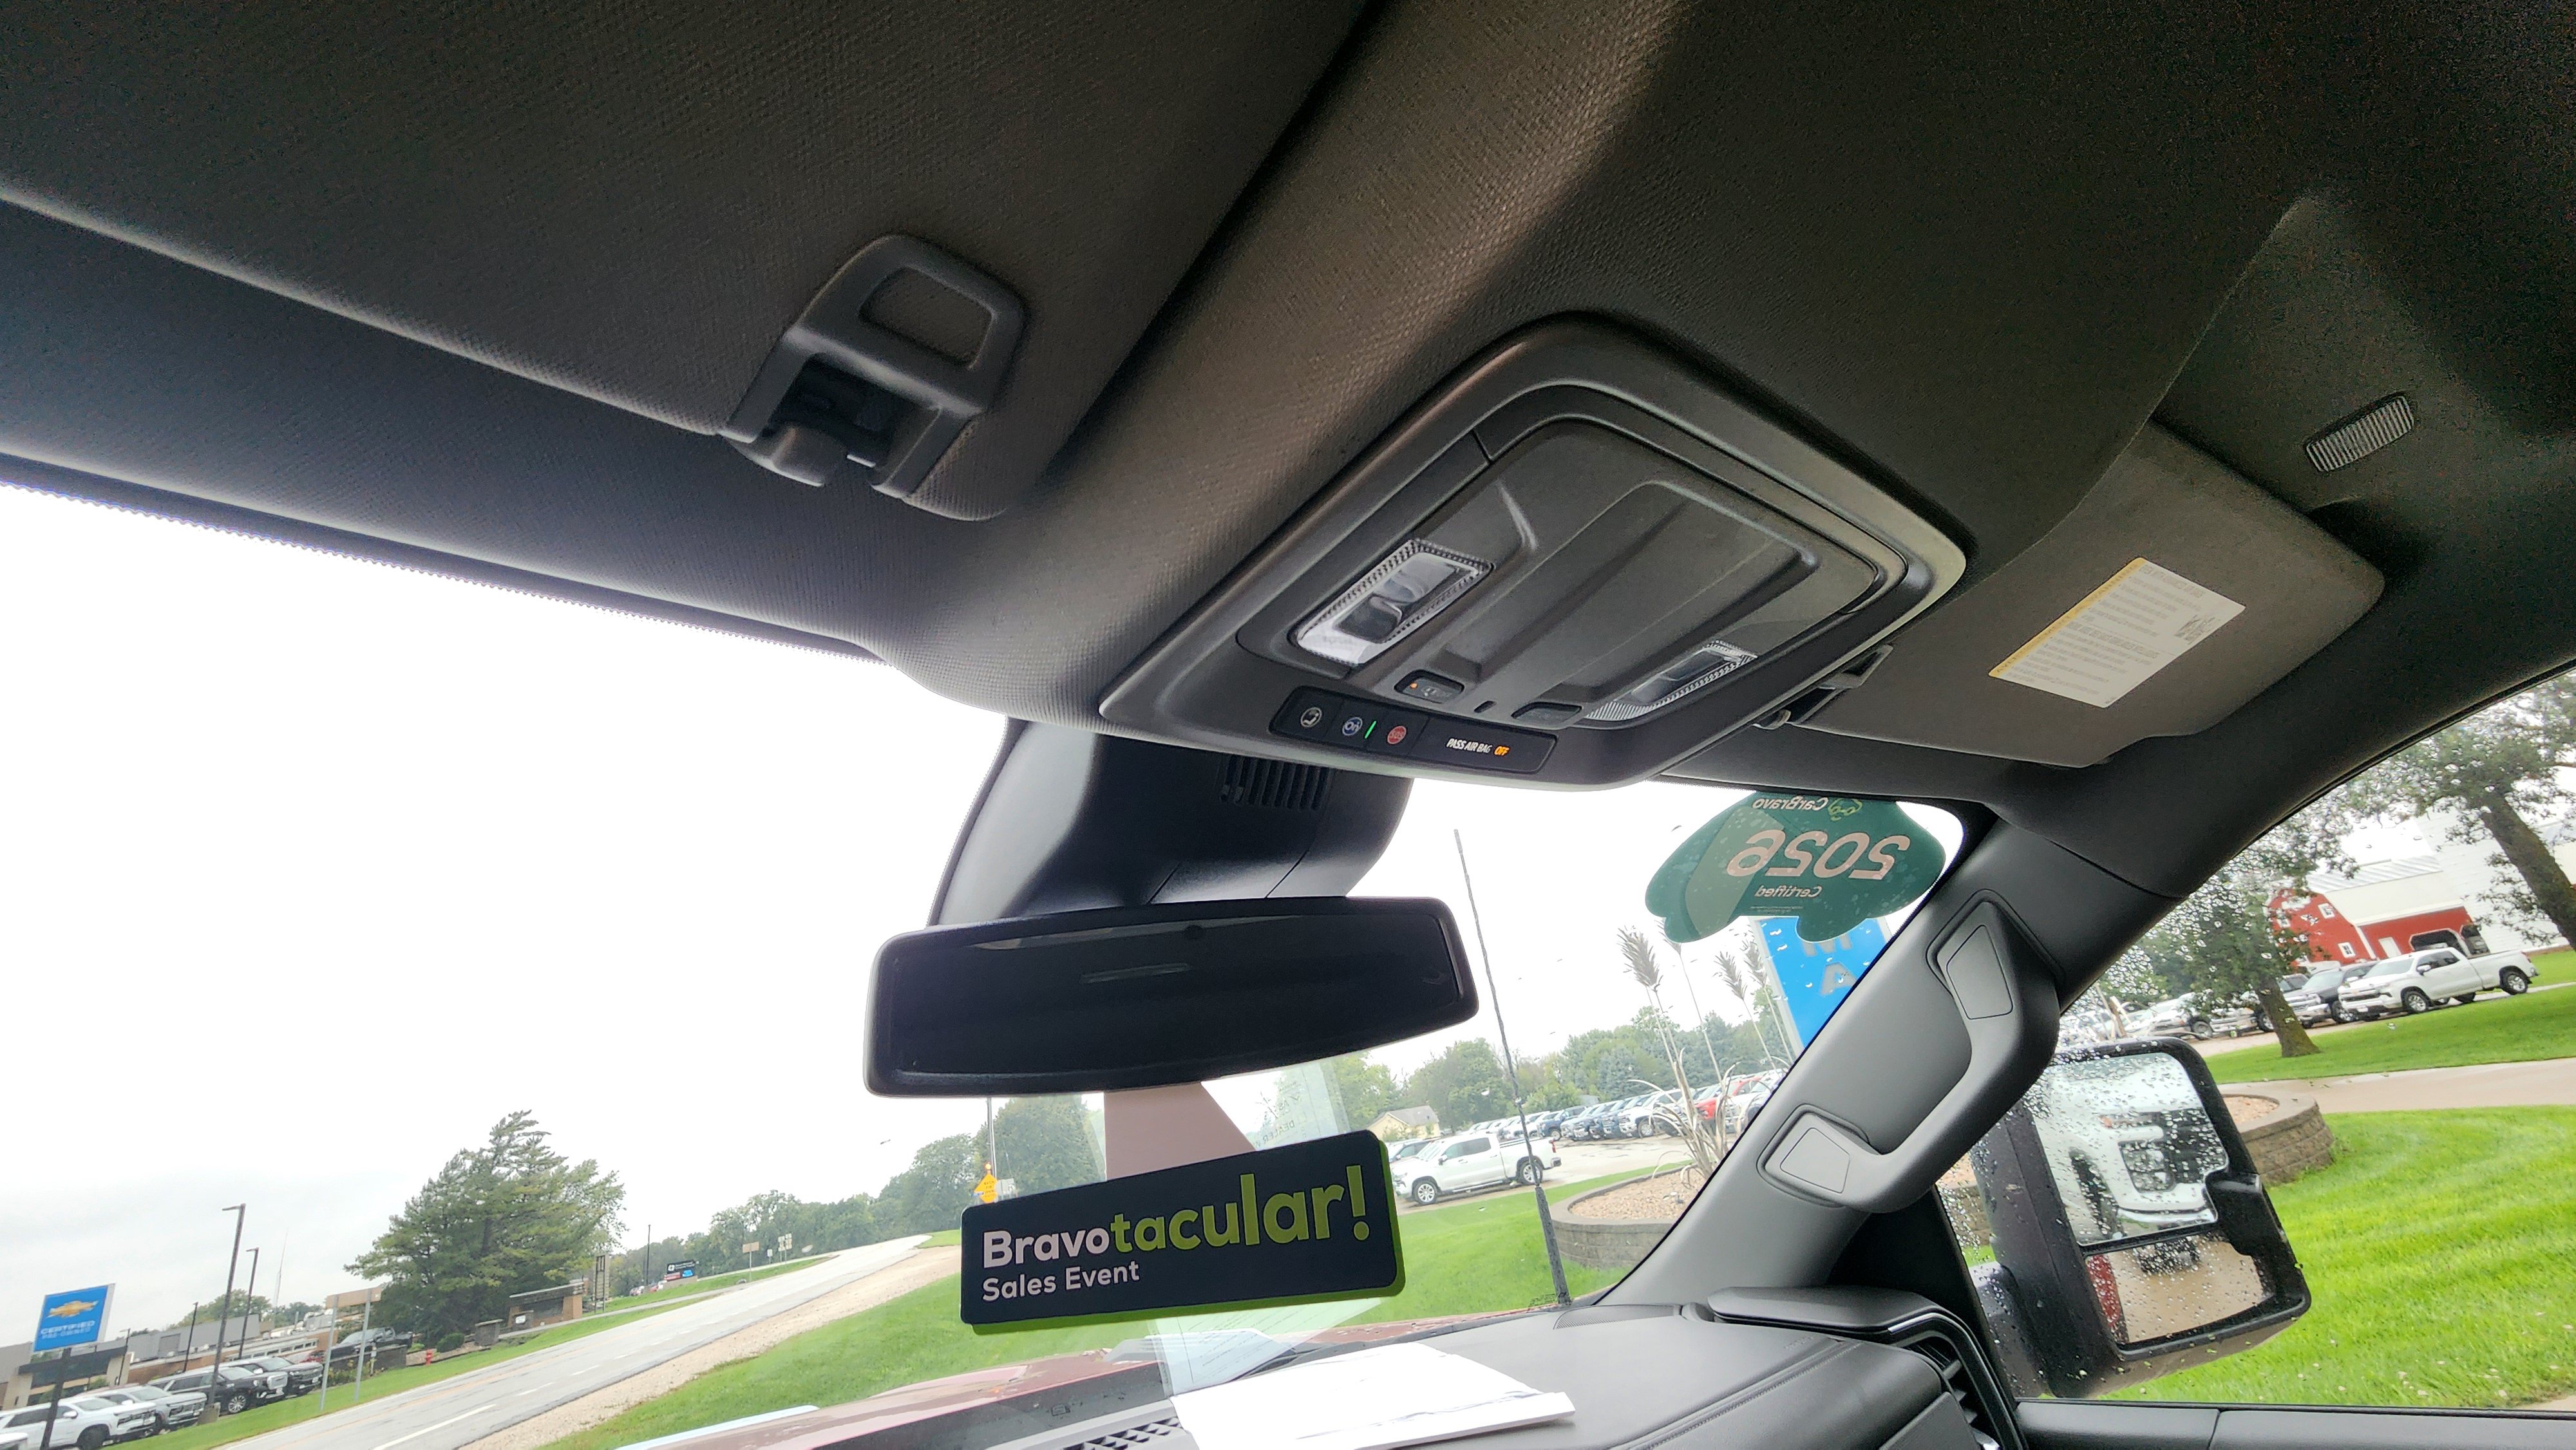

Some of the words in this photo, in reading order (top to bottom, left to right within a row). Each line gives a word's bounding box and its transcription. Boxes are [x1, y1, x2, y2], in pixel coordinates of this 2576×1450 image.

[1446, 738, 1467, 750] PASS
[1464, 741, 1479, 751] AIR
[1476, 743, 1493, 753] BAG
[1494, 746, 1510, 756] OFF
[983, 1164, 1370, 1268] Bravotacular!
[982, 1272, 1057, 1302] Sales
[1065, 1260, 1141, 1290] Event
[41, 1320, 95, 1335] CERTIFIED
